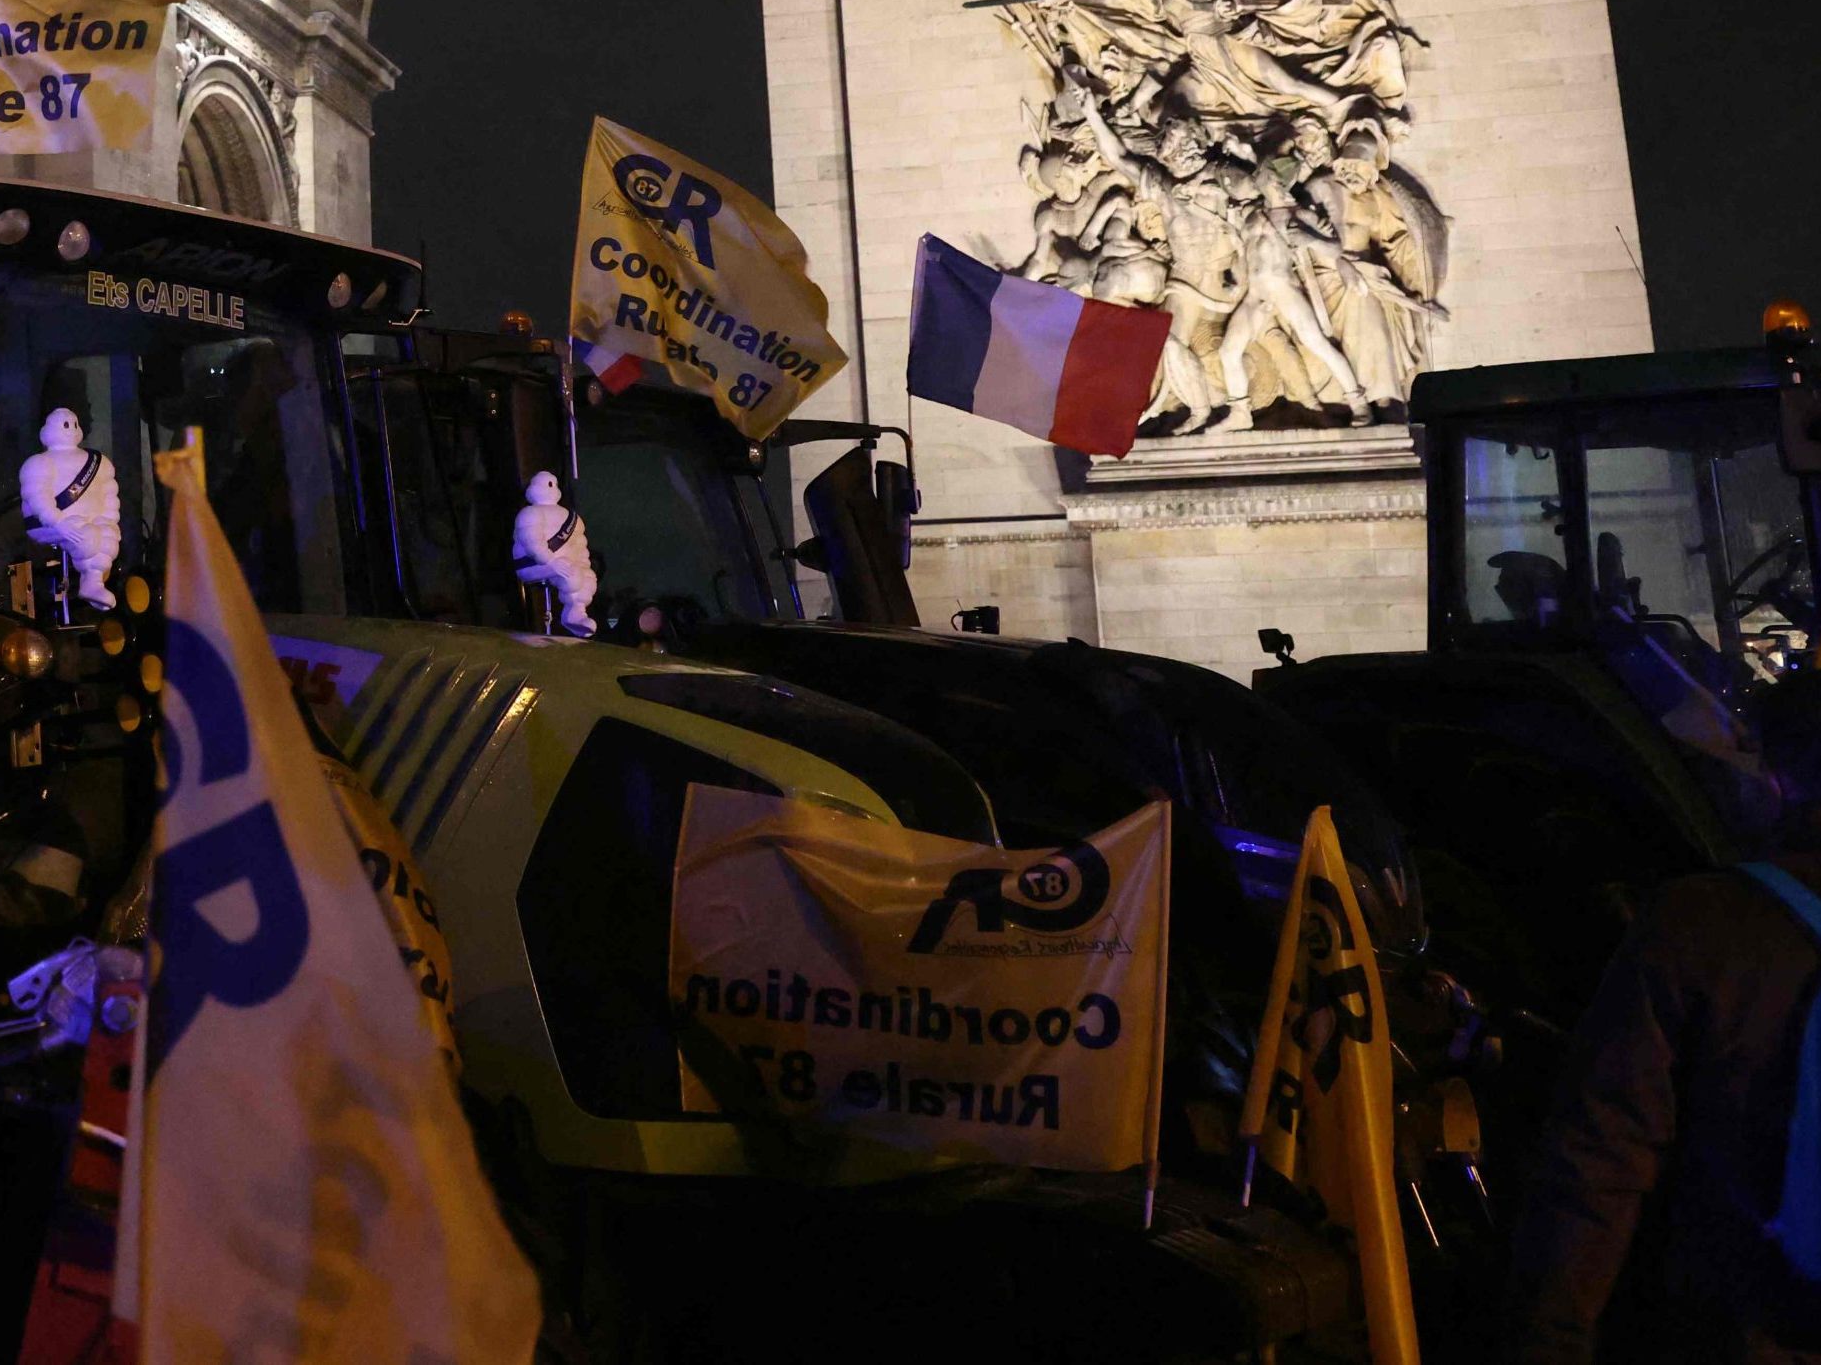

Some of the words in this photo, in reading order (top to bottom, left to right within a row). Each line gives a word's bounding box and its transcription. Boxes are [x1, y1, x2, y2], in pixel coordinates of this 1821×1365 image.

[39, 73, 91, 121] 87
[613, 154, 721, 270] CR
[87, 270, 129, 309] Ets
[135, 277, 245, 331] CAPELLE
[590, 237, 821, 383] Coordination
[729, 373, 773, 412] 87
